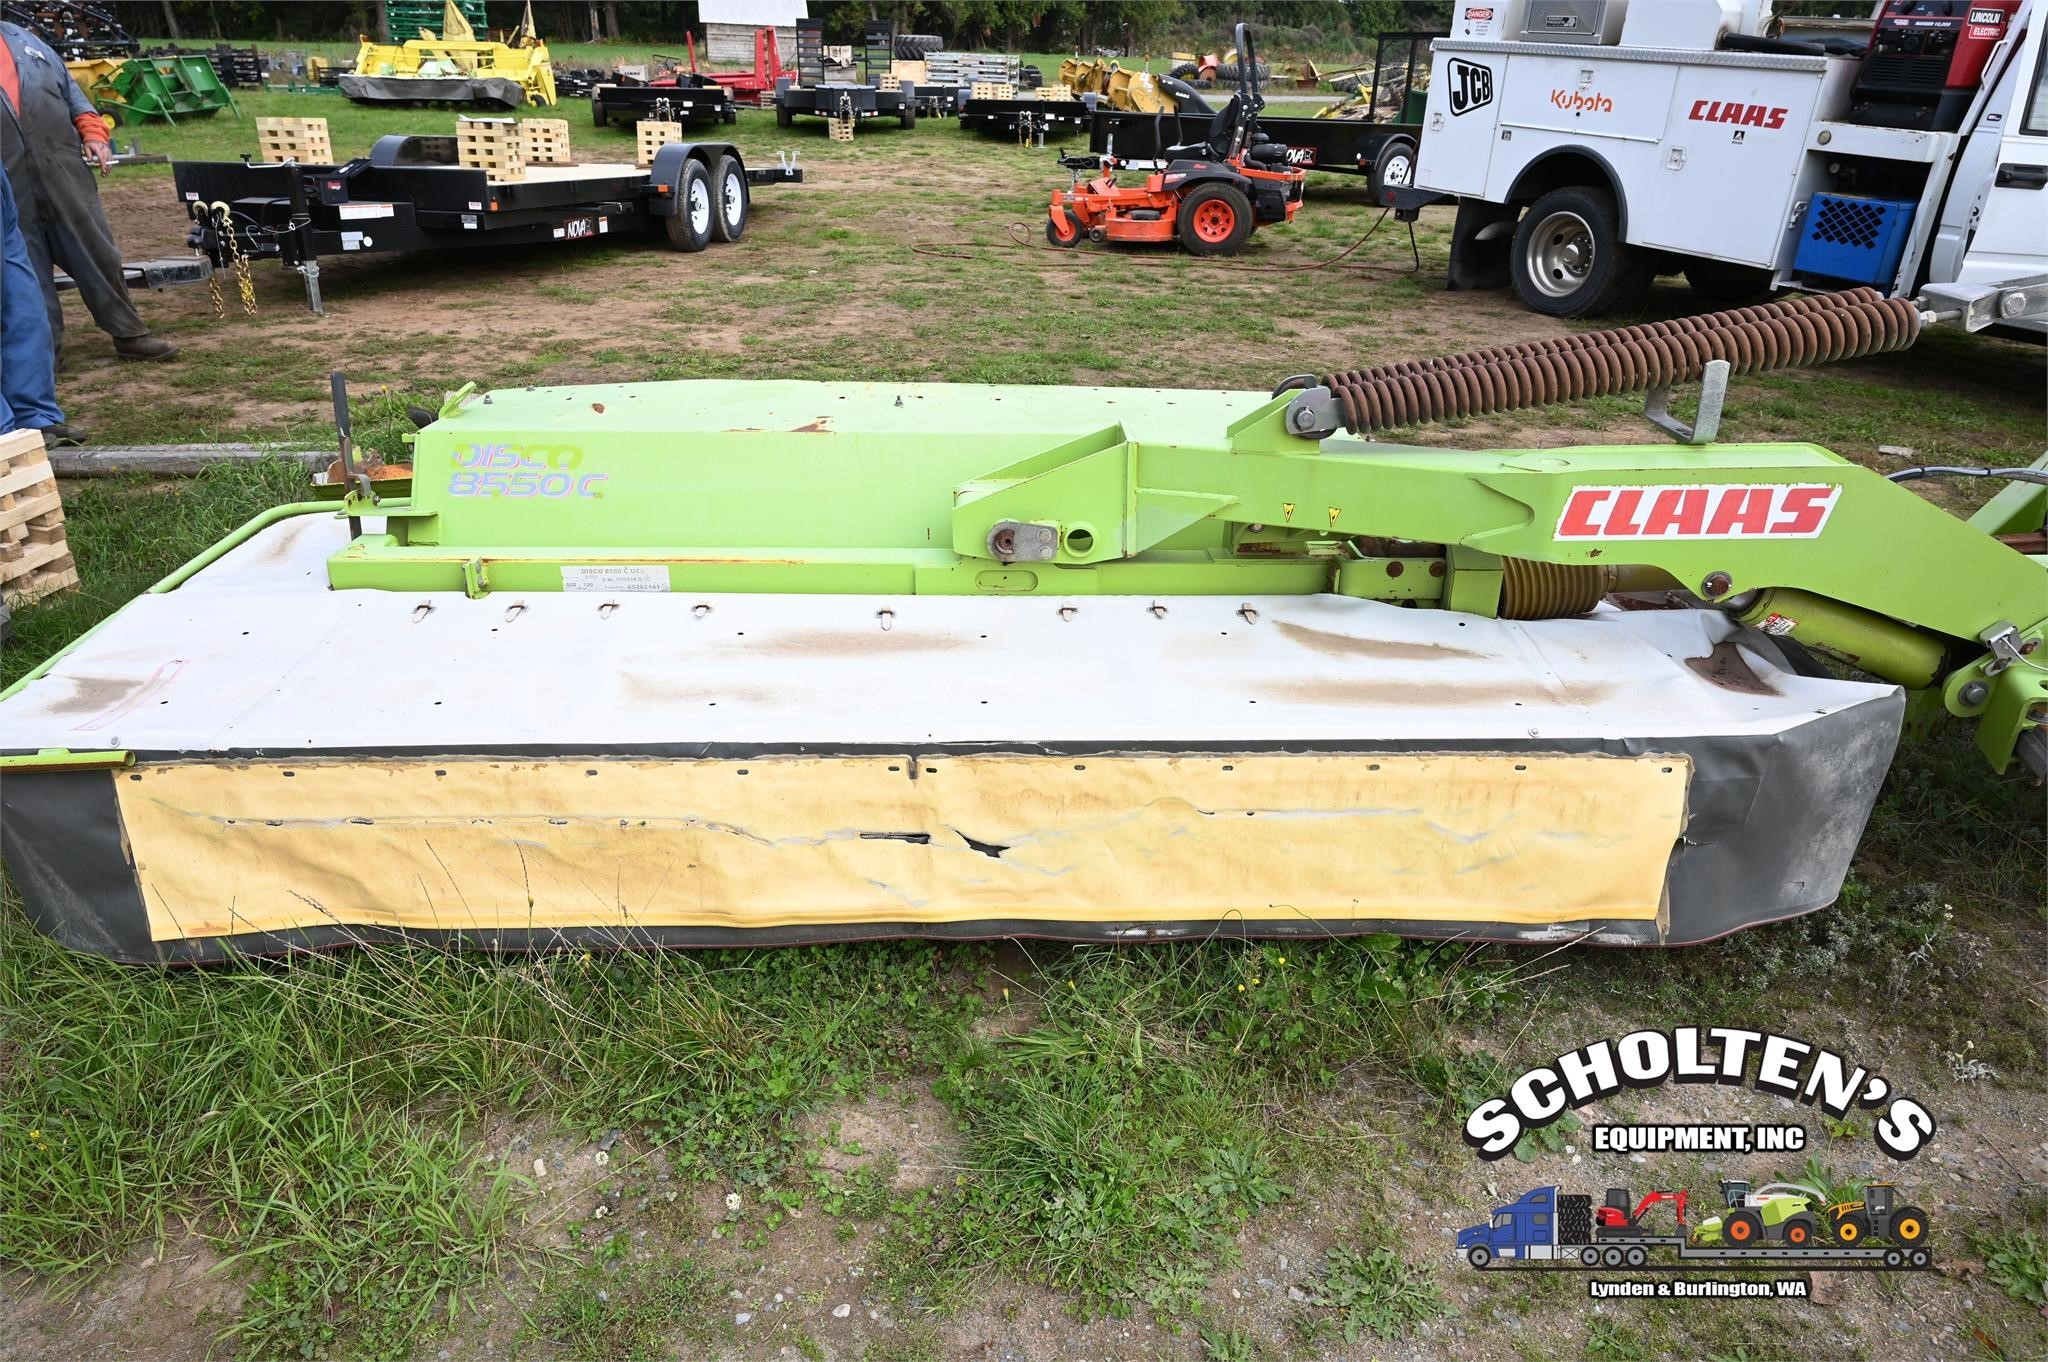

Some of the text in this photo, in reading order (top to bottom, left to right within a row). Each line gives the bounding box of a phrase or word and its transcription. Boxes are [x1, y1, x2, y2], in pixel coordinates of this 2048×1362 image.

[1467, 9, 1491, 18] DANGER
[1970, 11, 2001, 24] LINCOLN
[1973, 28, 2000, 36] ELECTRIC
[1453, 64, 1490, 110] JCB
[1551, 89, 1613, 113] Kubota
[1688, 100, 1789, 129] CLAAS
[567, 219, 586, 238] NOVA
[450, 443, 584, 470] DISCO
[1560, 487, 1832, 536] CLAAS
